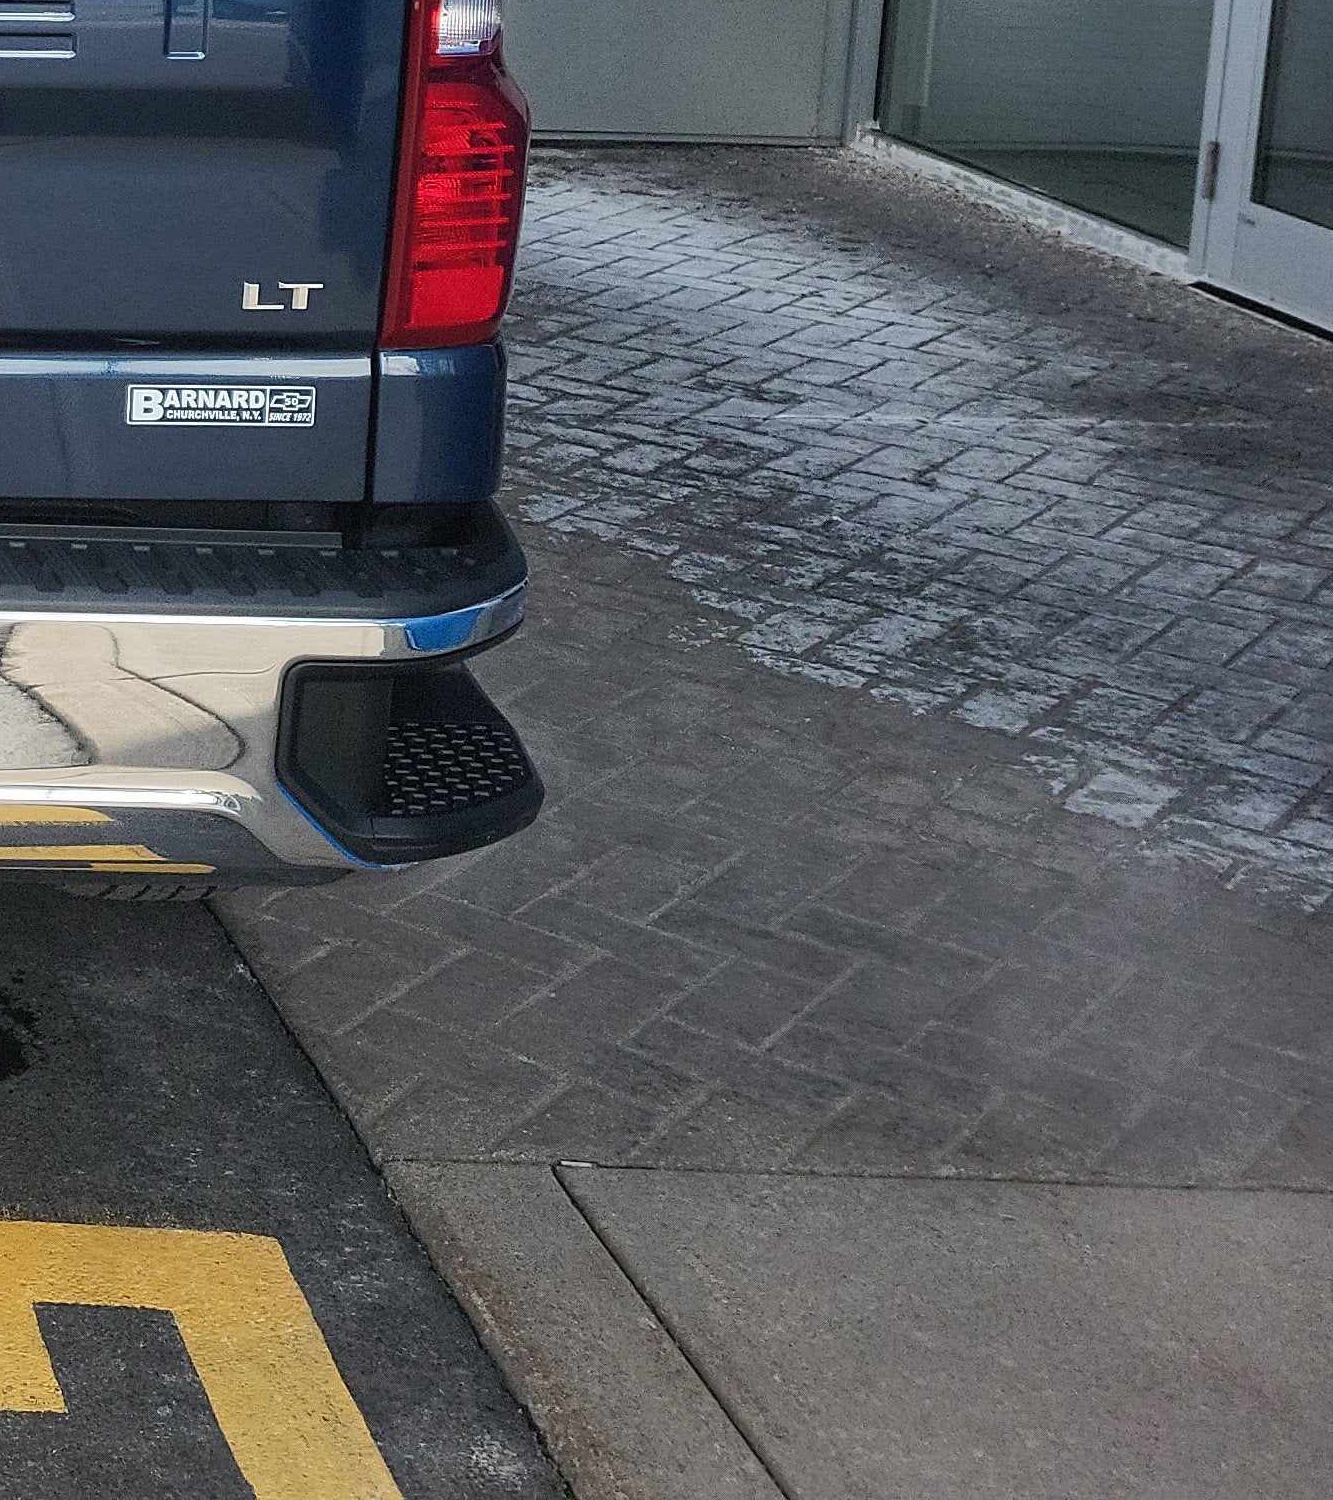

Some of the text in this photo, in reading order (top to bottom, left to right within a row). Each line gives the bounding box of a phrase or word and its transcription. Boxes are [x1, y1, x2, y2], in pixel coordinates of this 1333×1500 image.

[241, 281, 324, 310] LT
[131, 388, 266, 421] BARNARD
[284, 397, 299, 406] 50
[166, 409, 262, 422] CHURCHVILLE, N.Y.
[268, 411, 312, 422] SINCE 1972
